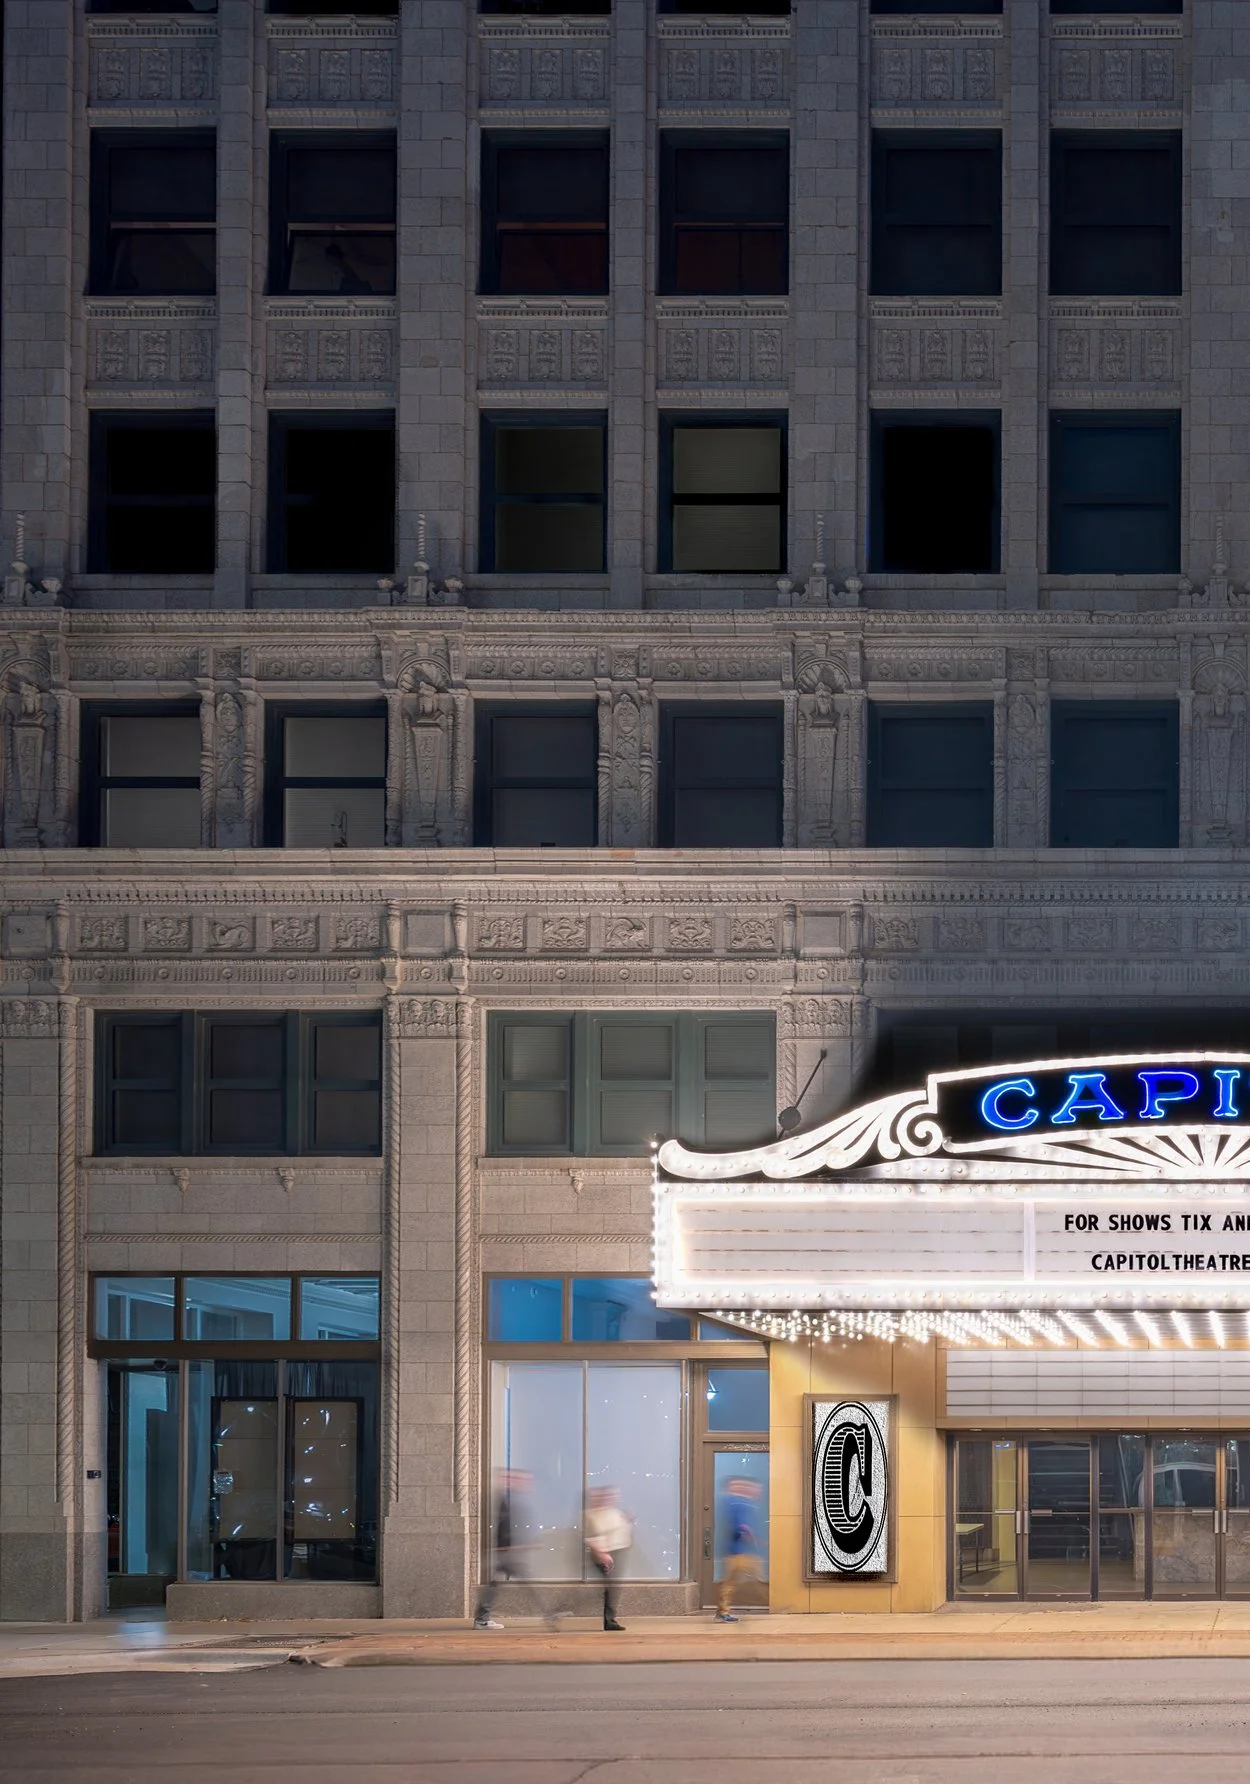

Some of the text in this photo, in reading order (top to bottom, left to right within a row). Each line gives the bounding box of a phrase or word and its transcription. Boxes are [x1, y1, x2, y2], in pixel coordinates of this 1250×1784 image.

[1064, 1214, 1099, 1231] FOR
[1109, 1214, 1172, 1231] SHOWS
[1181, 1214, 1212, 1231] TIX
[821, 1421, 875, 1556] C
